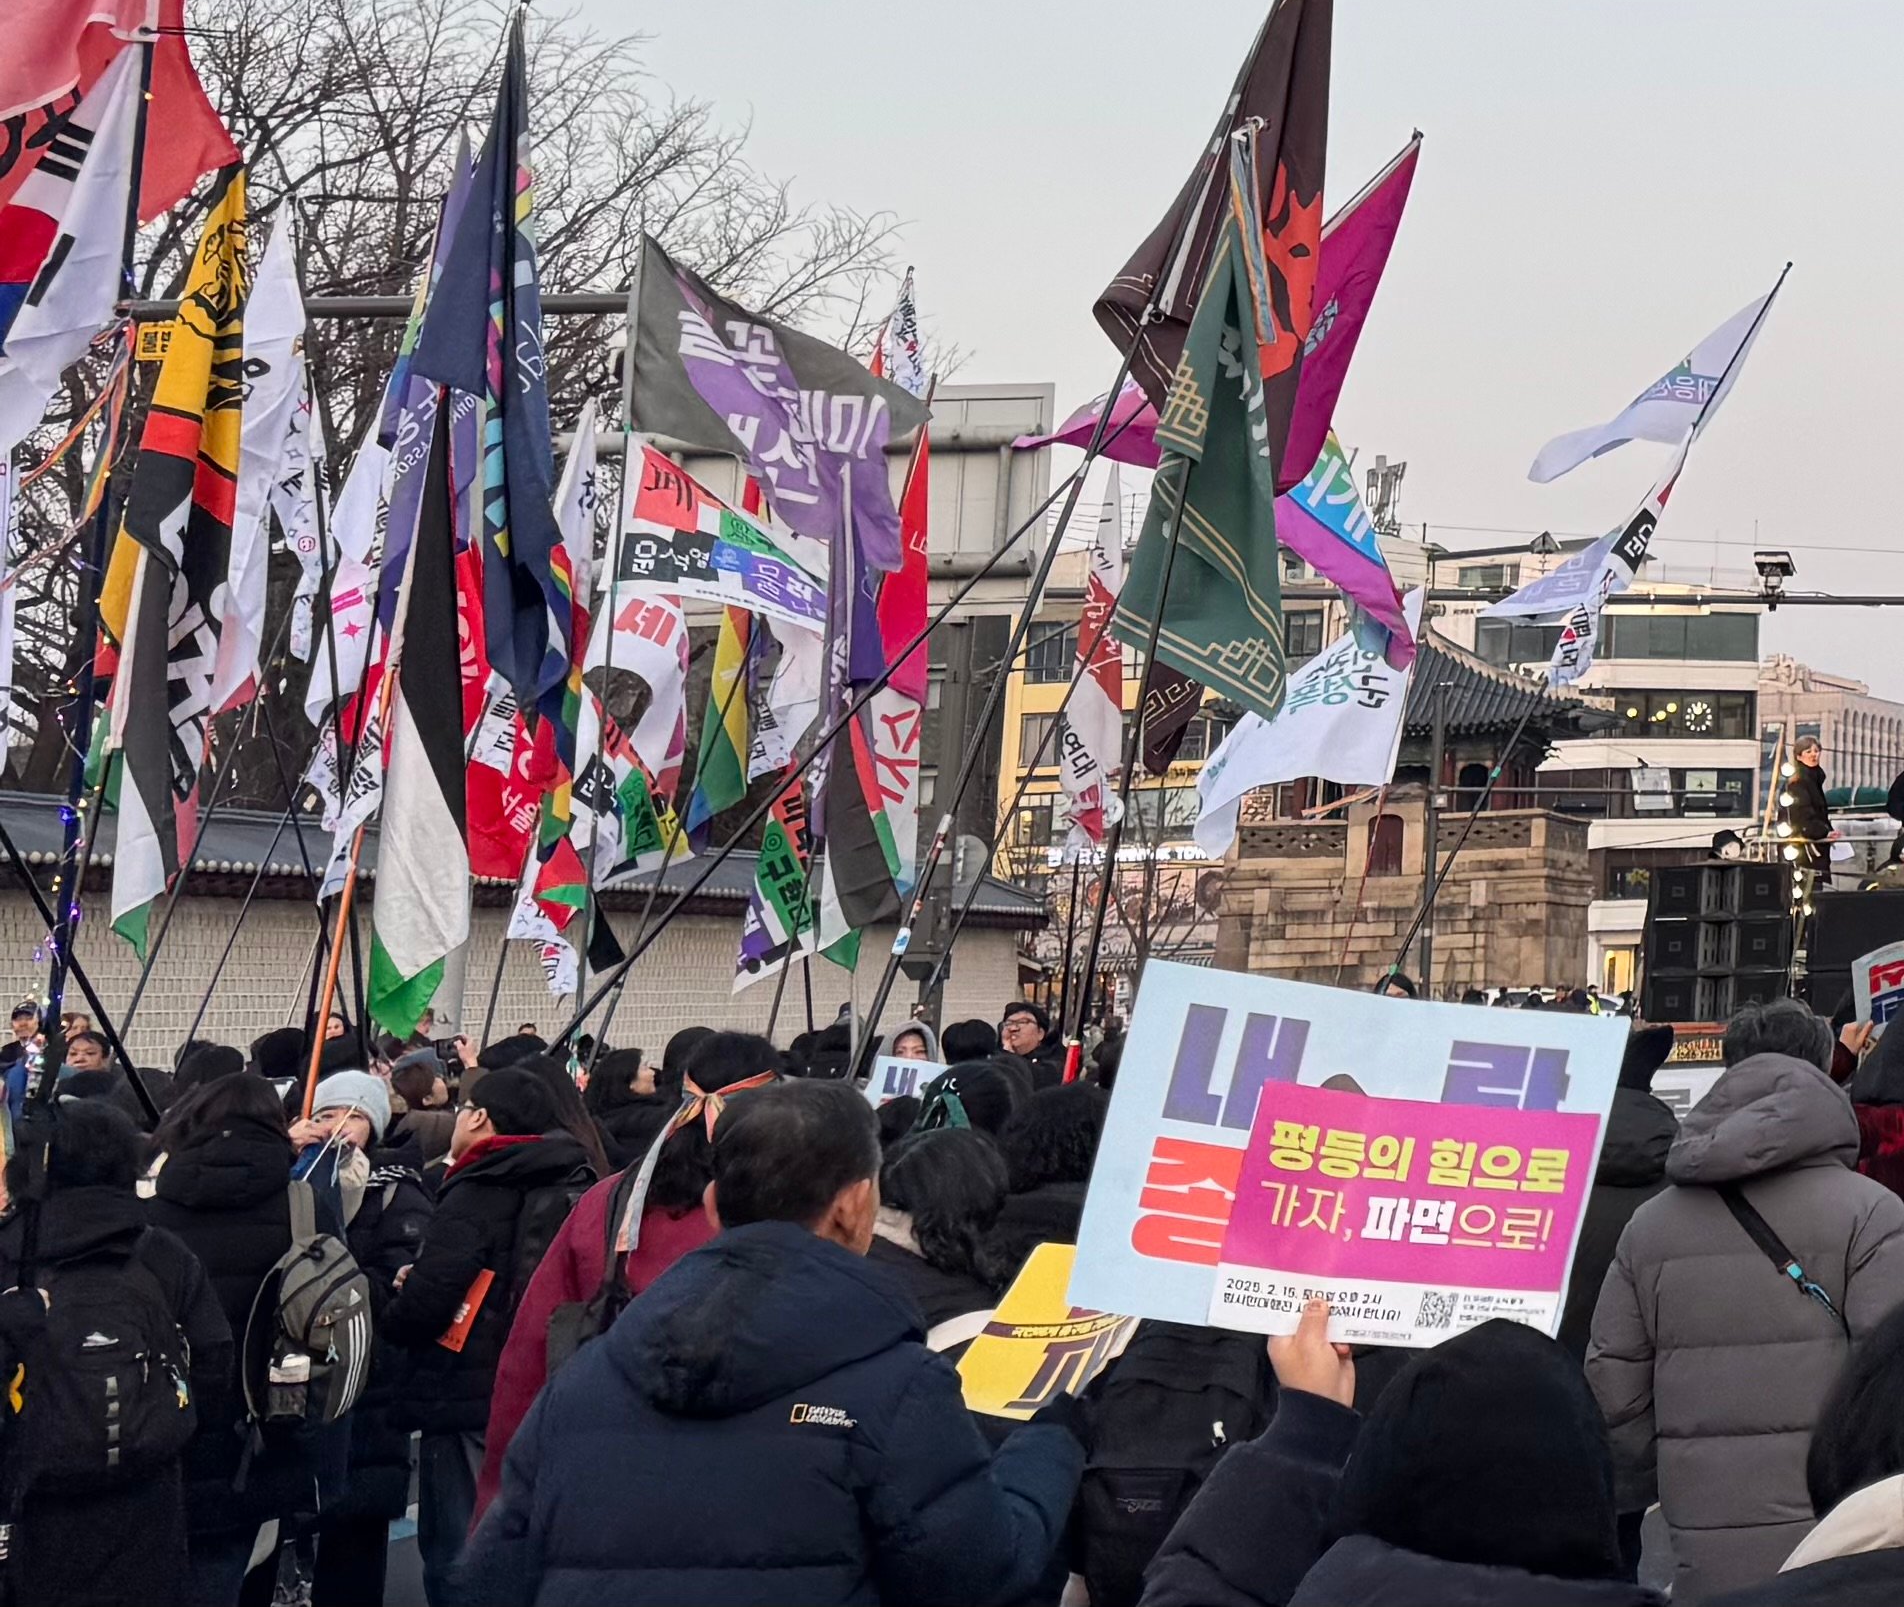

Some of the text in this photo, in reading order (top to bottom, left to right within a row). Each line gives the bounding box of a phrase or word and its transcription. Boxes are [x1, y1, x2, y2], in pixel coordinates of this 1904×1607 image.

[1269, 1119, 1571, 1194] 평등의 힘으로
[1260, 1179, 1555, 1253] 가자, 파면으로!
